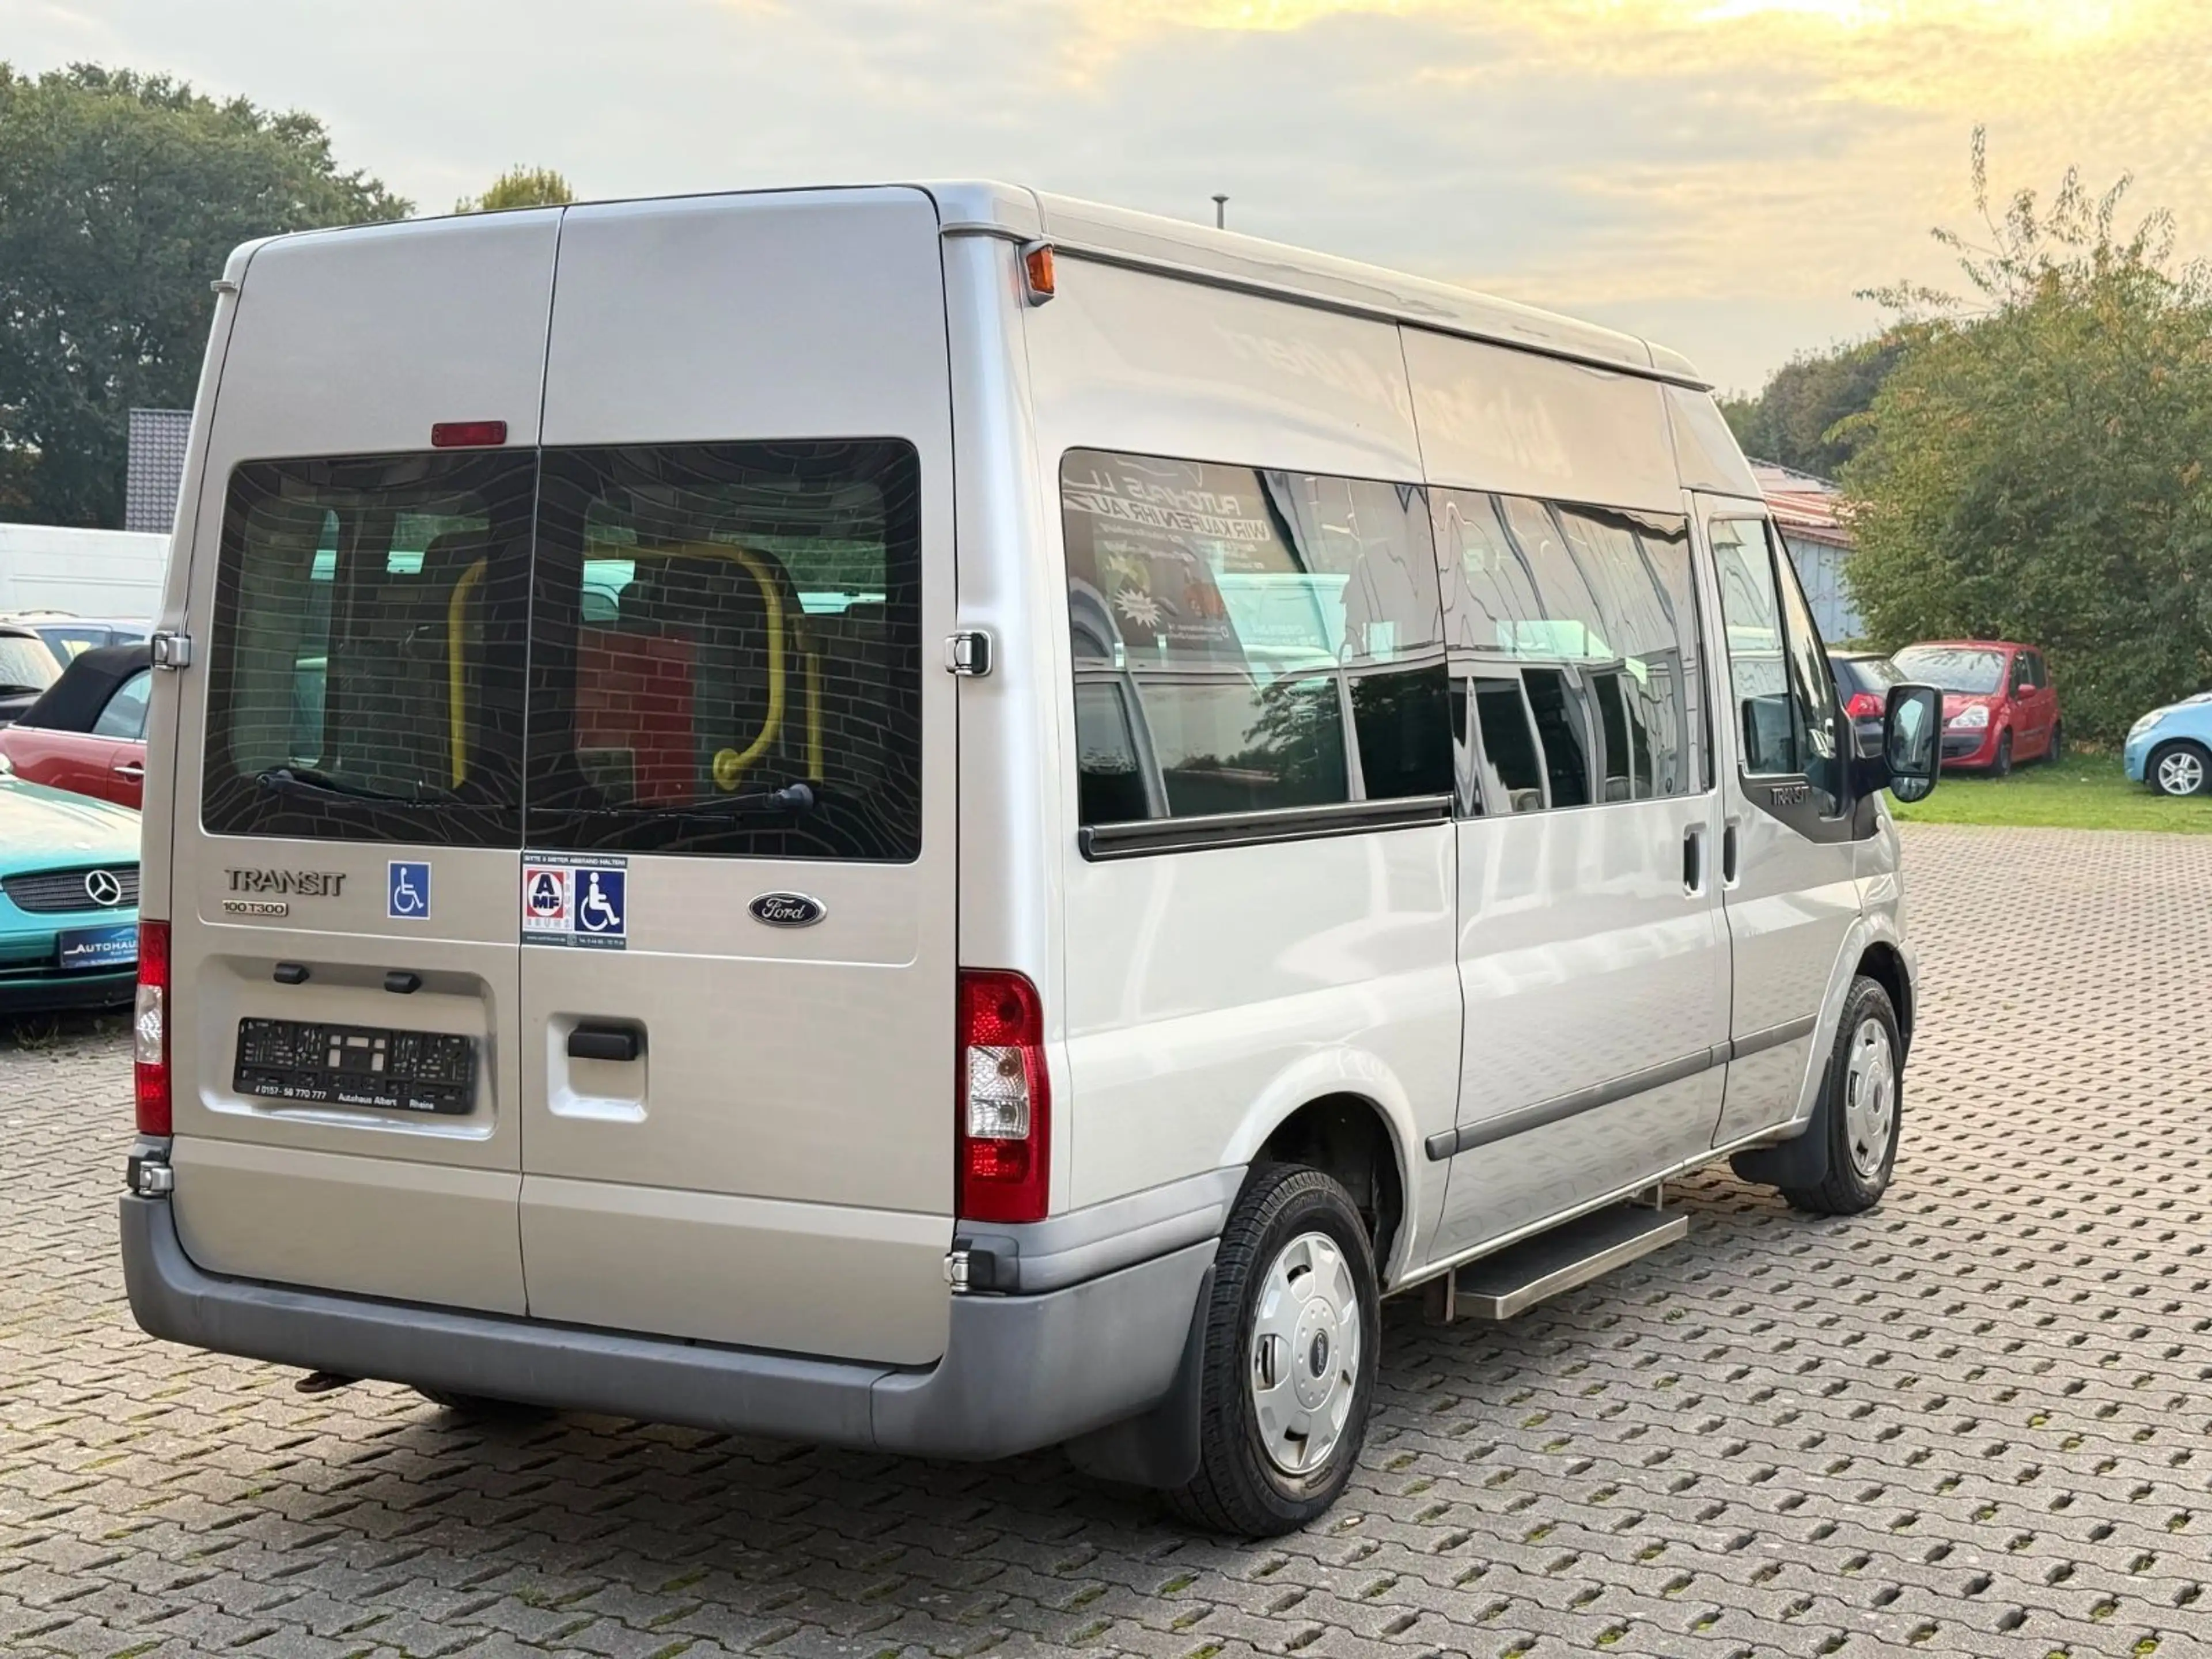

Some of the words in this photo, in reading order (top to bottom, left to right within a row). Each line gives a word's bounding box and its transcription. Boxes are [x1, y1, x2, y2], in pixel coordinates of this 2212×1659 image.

[1770, 786, 1809, 806] TRANSIT
[224, 866, 347, 896] TRANSIT
[762, 898, 806, 919] Ford
[75, 940, 137, 953] AUTOHAU
